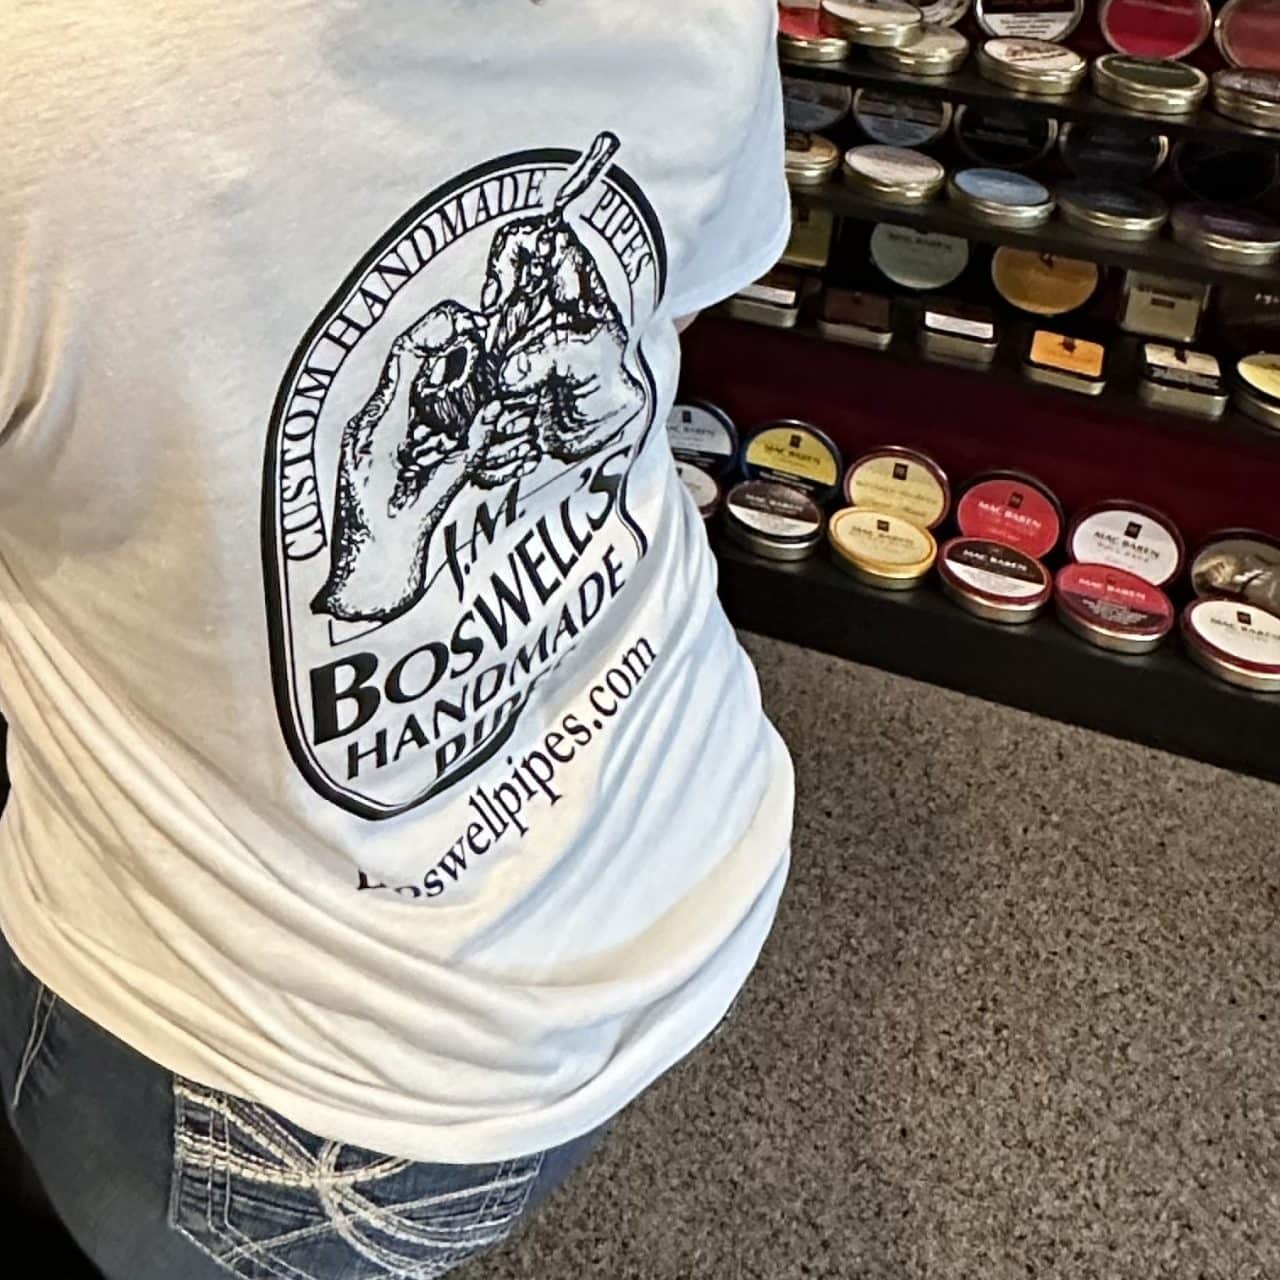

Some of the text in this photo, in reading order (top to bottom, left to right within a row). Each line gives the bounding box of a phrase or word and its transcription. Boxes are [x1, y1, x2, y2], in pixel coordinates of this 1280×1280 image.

[280, 169, 655, 562] CUSTOM HANDMADE PIPES
[309, 450, 631, 746] BOSWELL'S
[346, 546, 626, 780] HANDMADE
